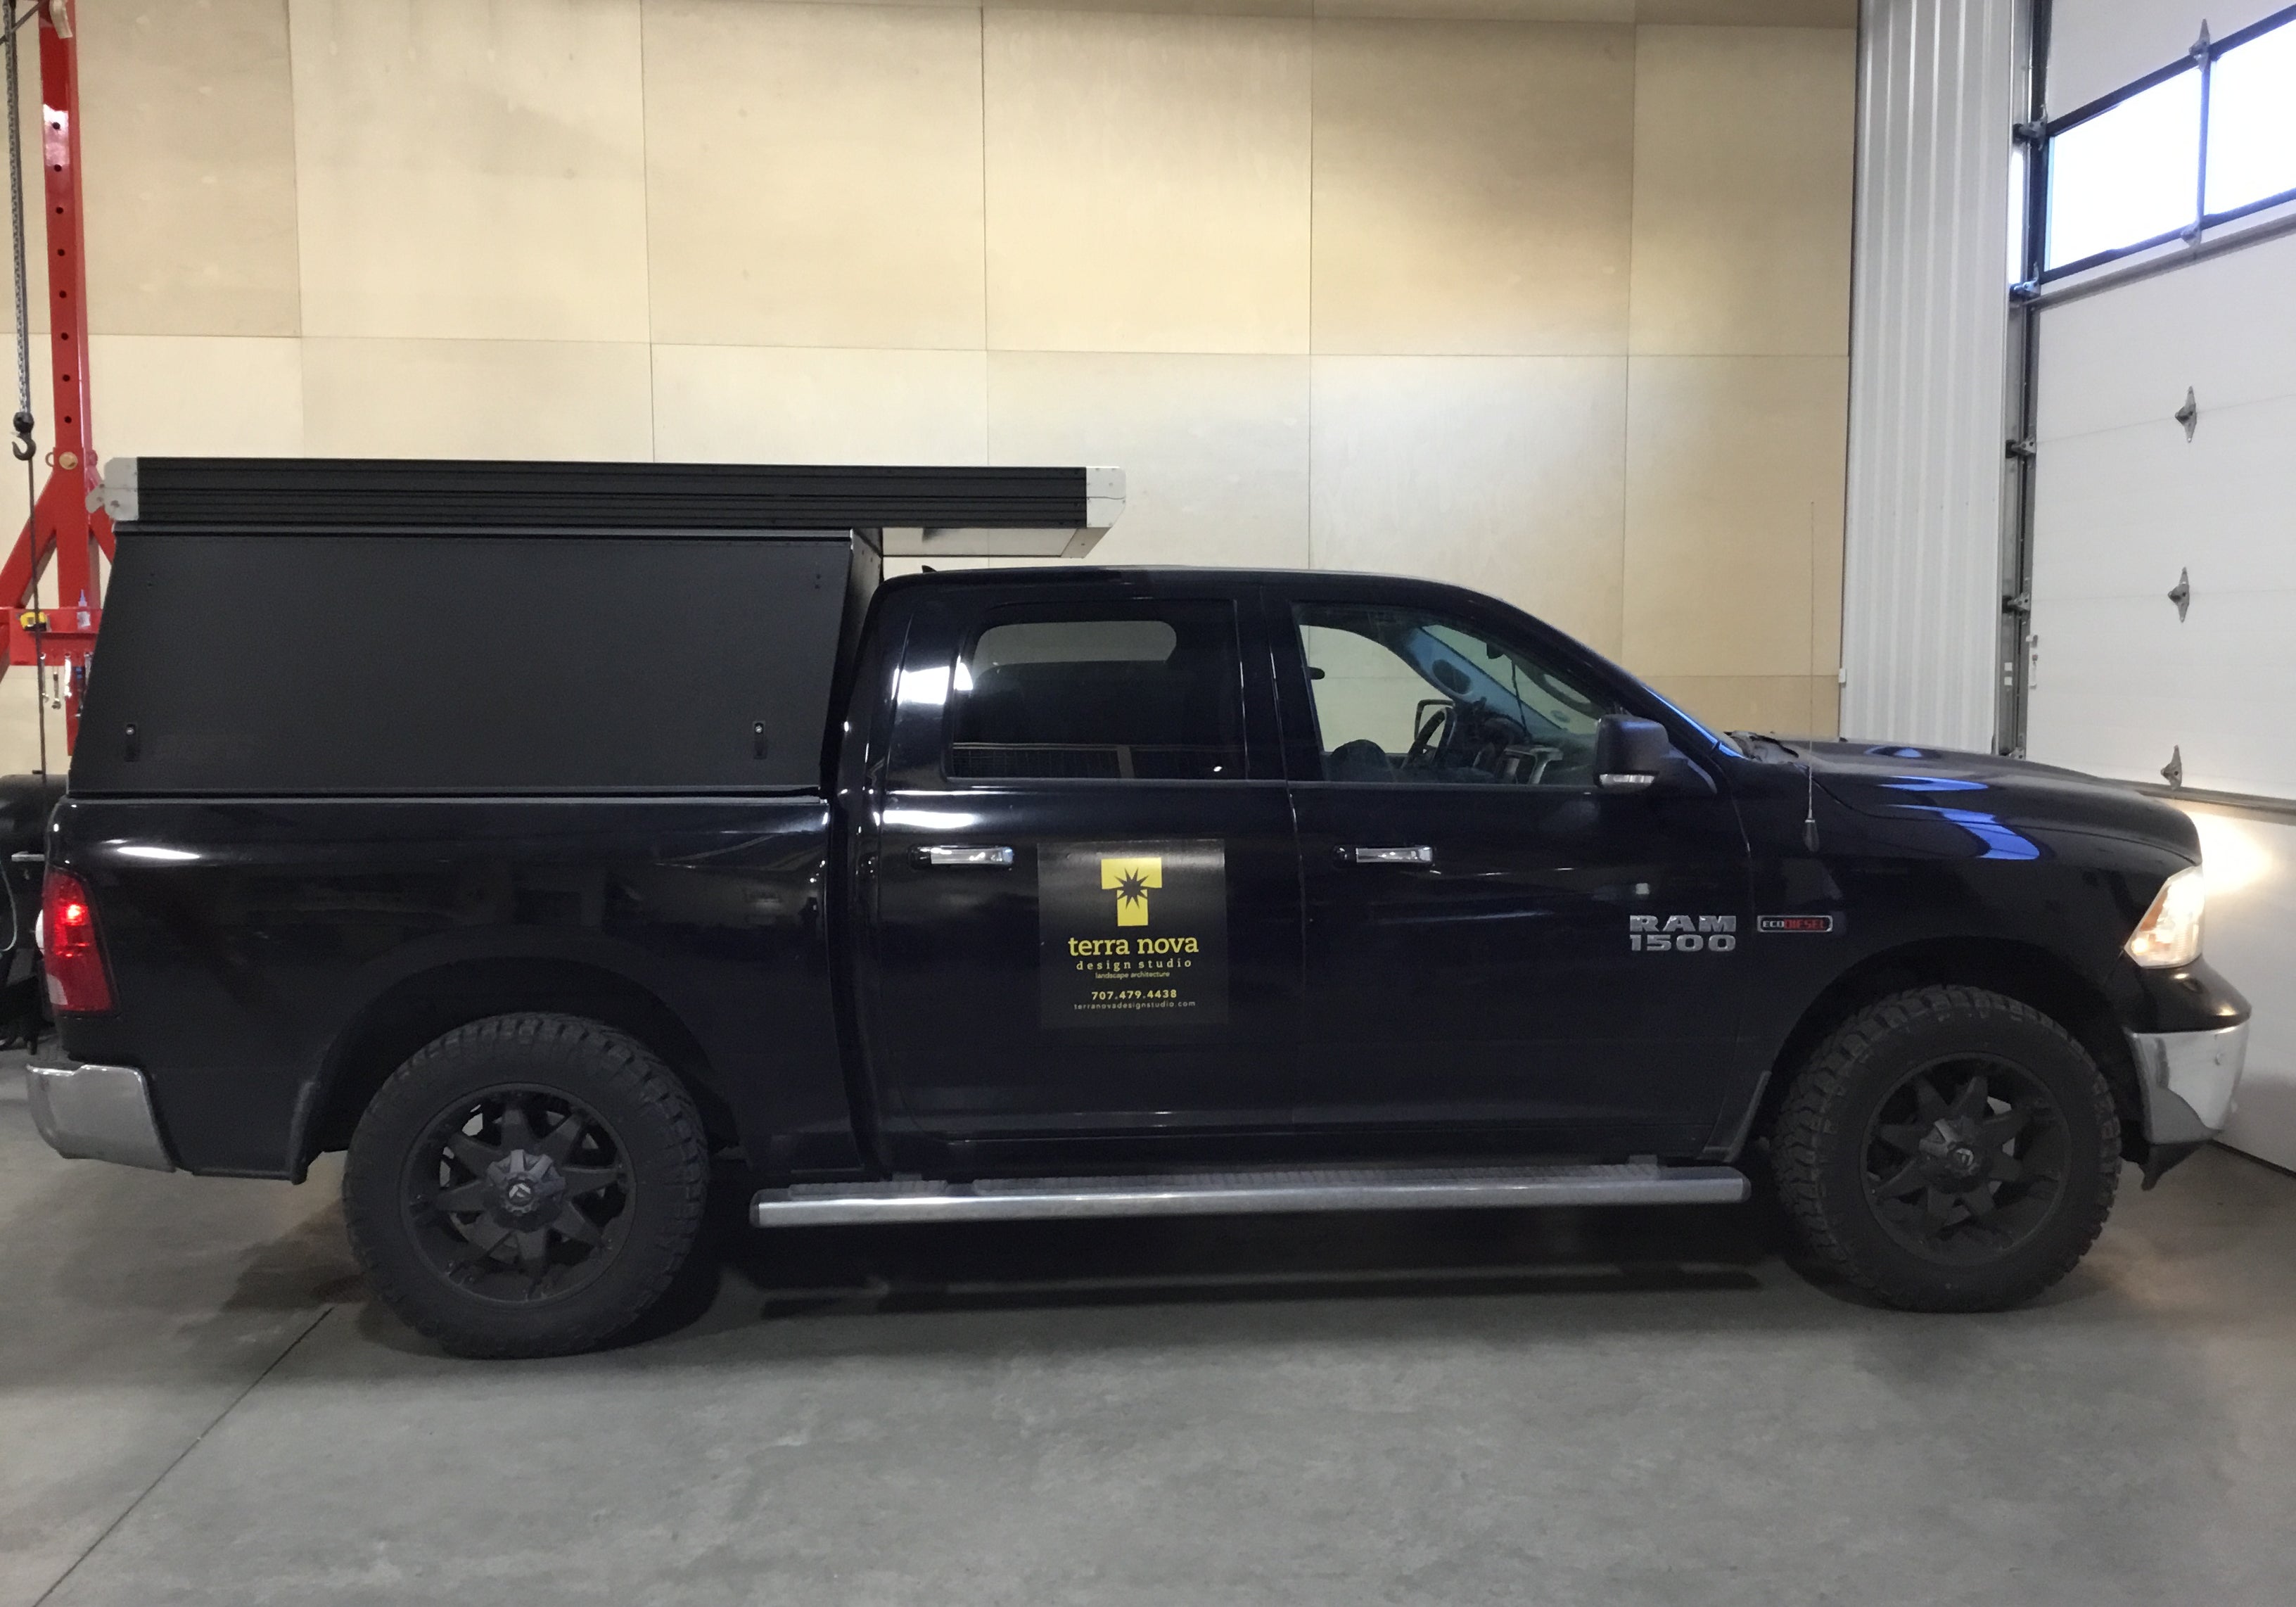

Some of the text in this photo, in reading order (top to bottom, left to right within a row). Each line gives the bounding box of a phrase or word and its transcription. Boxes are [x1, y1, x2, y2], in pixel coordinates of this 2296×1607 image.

[1629, 915, 1737, 932] RAM
[1067, 936, 1199, 956] terra nova
[1629, 934, 1737, 951] 1500
[1076, 958, 1192, 972] design studio
[1095, 972, 1129, 980] landscape
[1091, 989, 1178, 1001] 707.479.4438
[1073, 1000, 1196, 1010] terranovadesignstudio.com
